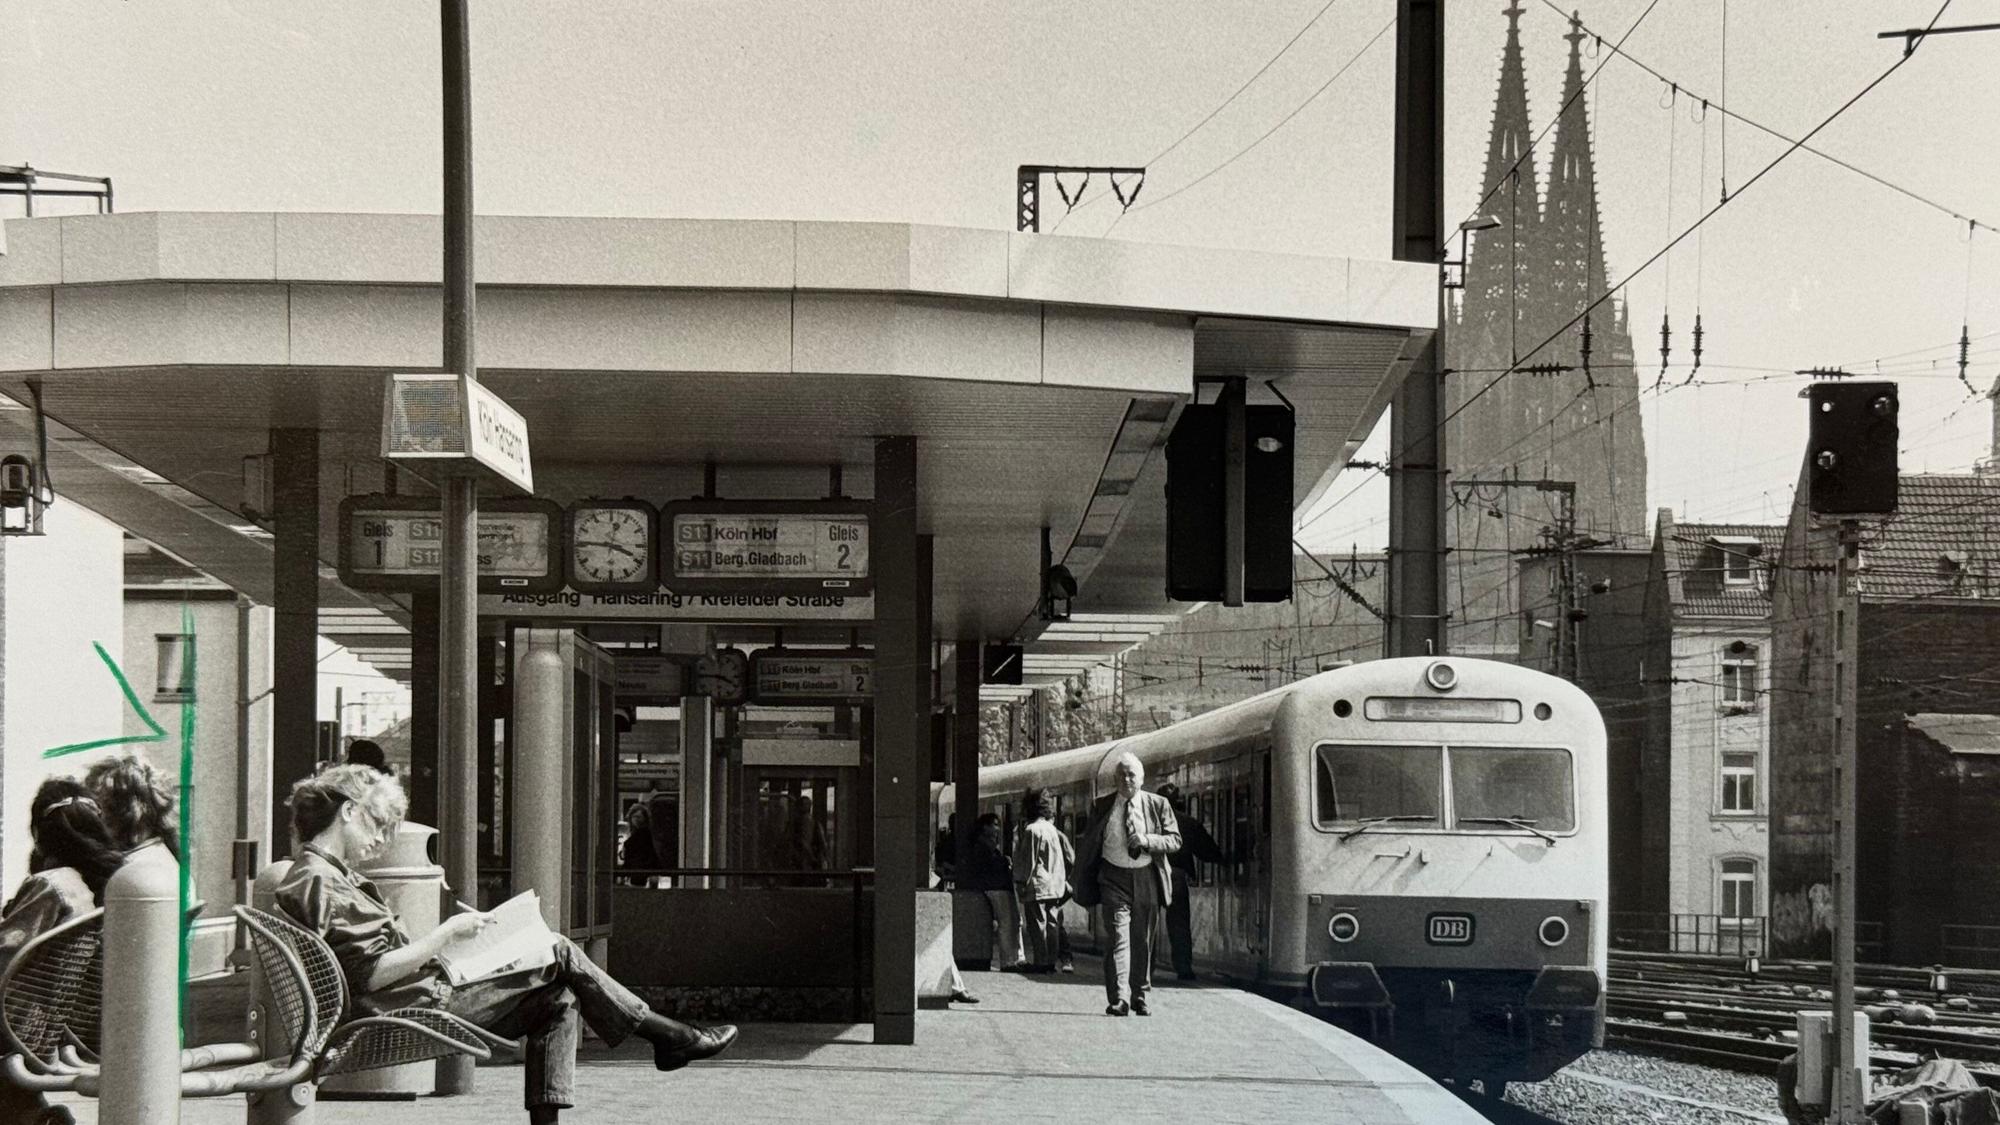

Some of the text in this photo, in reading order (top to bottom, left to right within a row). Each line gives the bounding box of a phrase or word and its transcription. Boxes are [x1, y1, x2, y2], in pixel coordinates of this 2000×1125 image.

[363, 521, 393, 538] Gleis
[412, 523, 440, 536] S11
[682, 526, 778, 541] S11 Köln Hbf
[829, 525, 859, 541] Gleis
[375, 540, 382, 565] 1
[412, 552, 440, 564] S11
[682, 553, 710, 566] S11
[837, 543, 851, 569] 2
[502, 591, 581, 607] Ausgang
[593, 591, 682, 608] Hansaring
[701, 594, 781, 607] Krefelder
[786, 595, 845, 608] Straße
[856, 676, 865, 692] 2
[1436, 920, 1464, 937] DB
